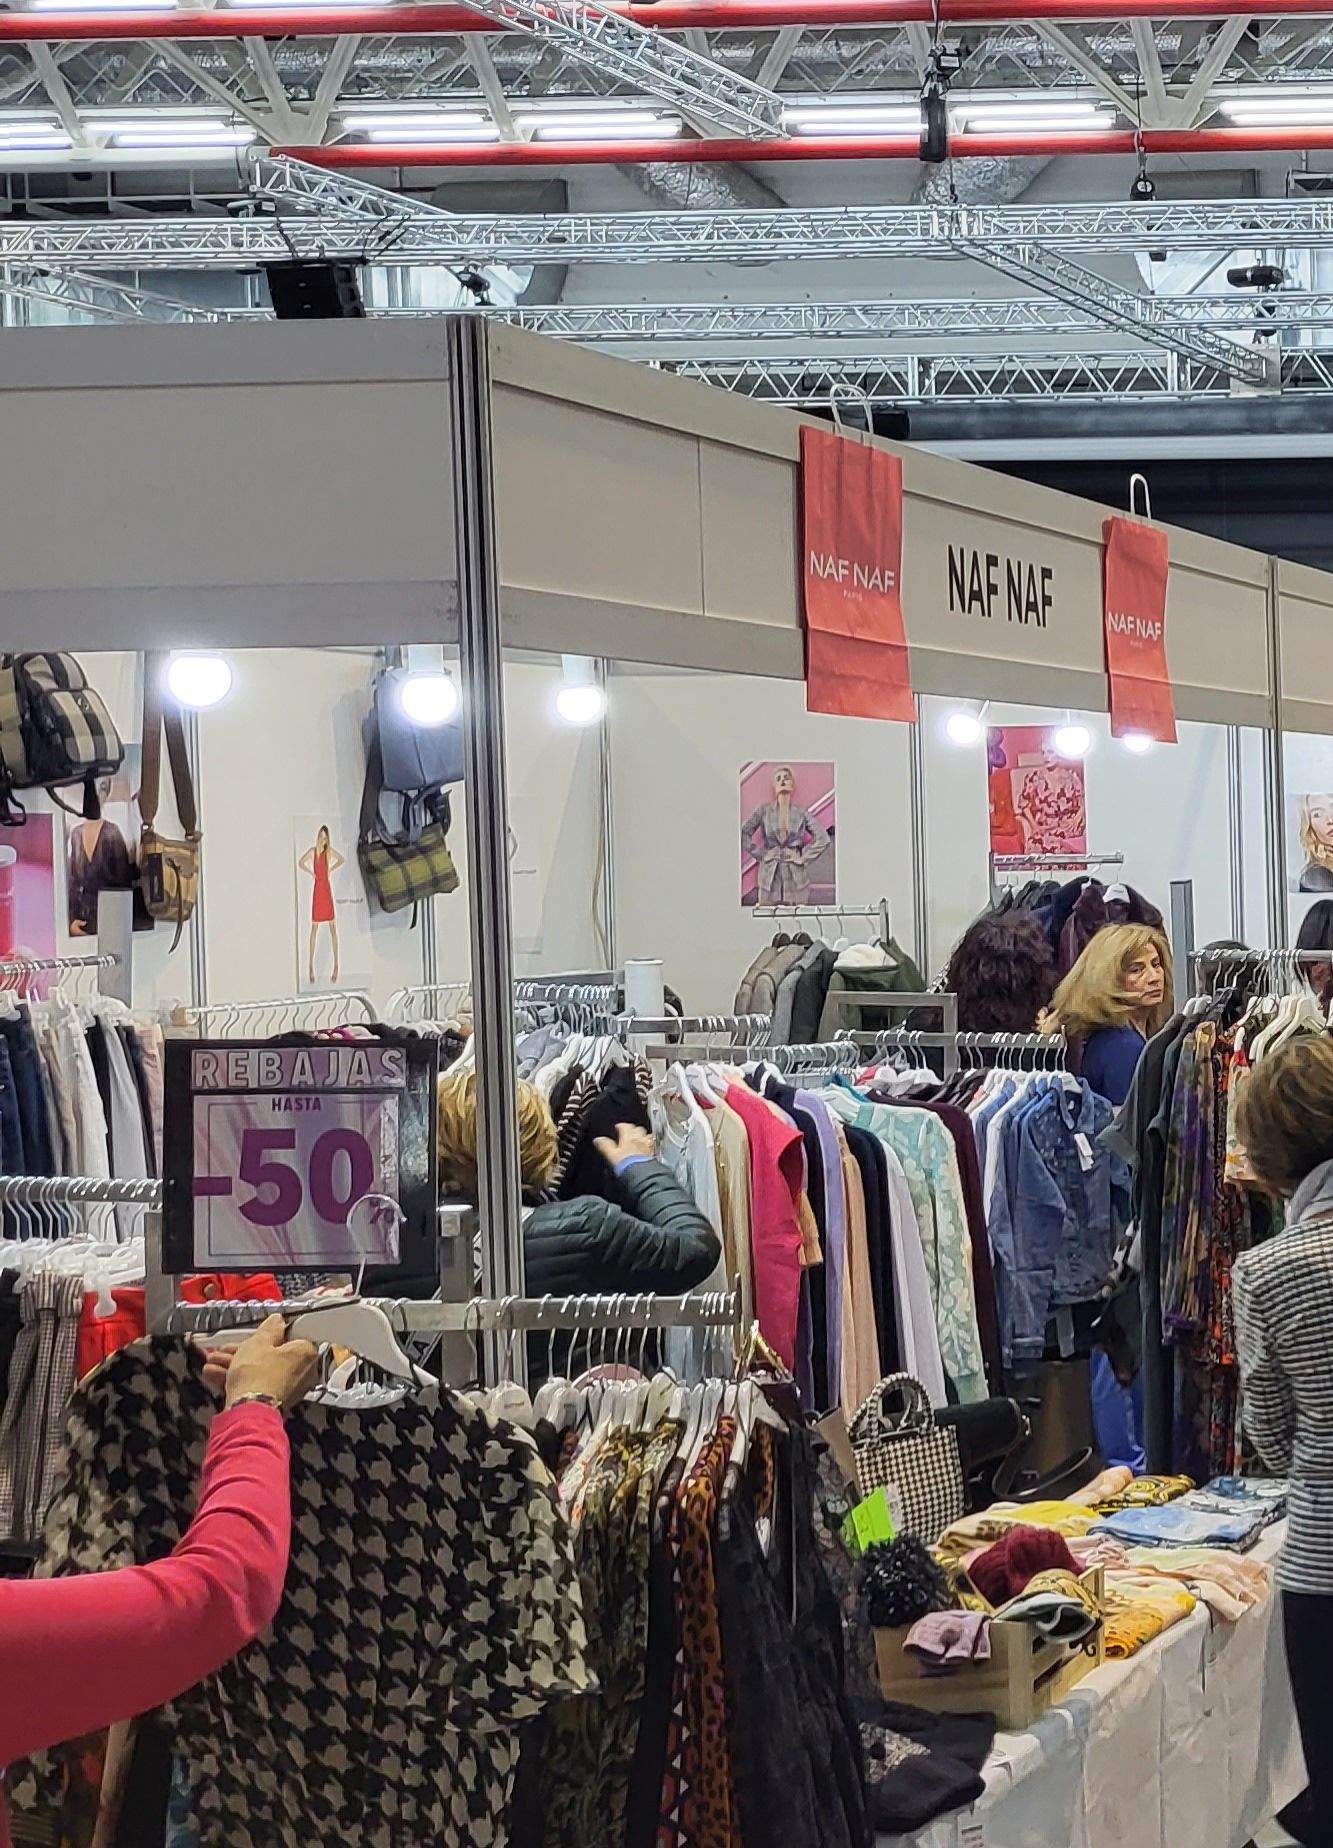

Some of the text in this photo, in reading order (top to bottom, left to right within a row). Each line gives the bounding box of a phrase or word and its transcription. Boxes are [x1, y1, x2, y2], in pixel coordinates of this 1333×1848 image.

[809, 549, 896, 594] NAF NAF
[947, 543, 1053, 628] NAF NAF
[1108, 611, 1162, 641] NAF NAF
[193, 1049, 405, 1089] REBAJAS
[271, 1097, 322, 1113] HASTA
